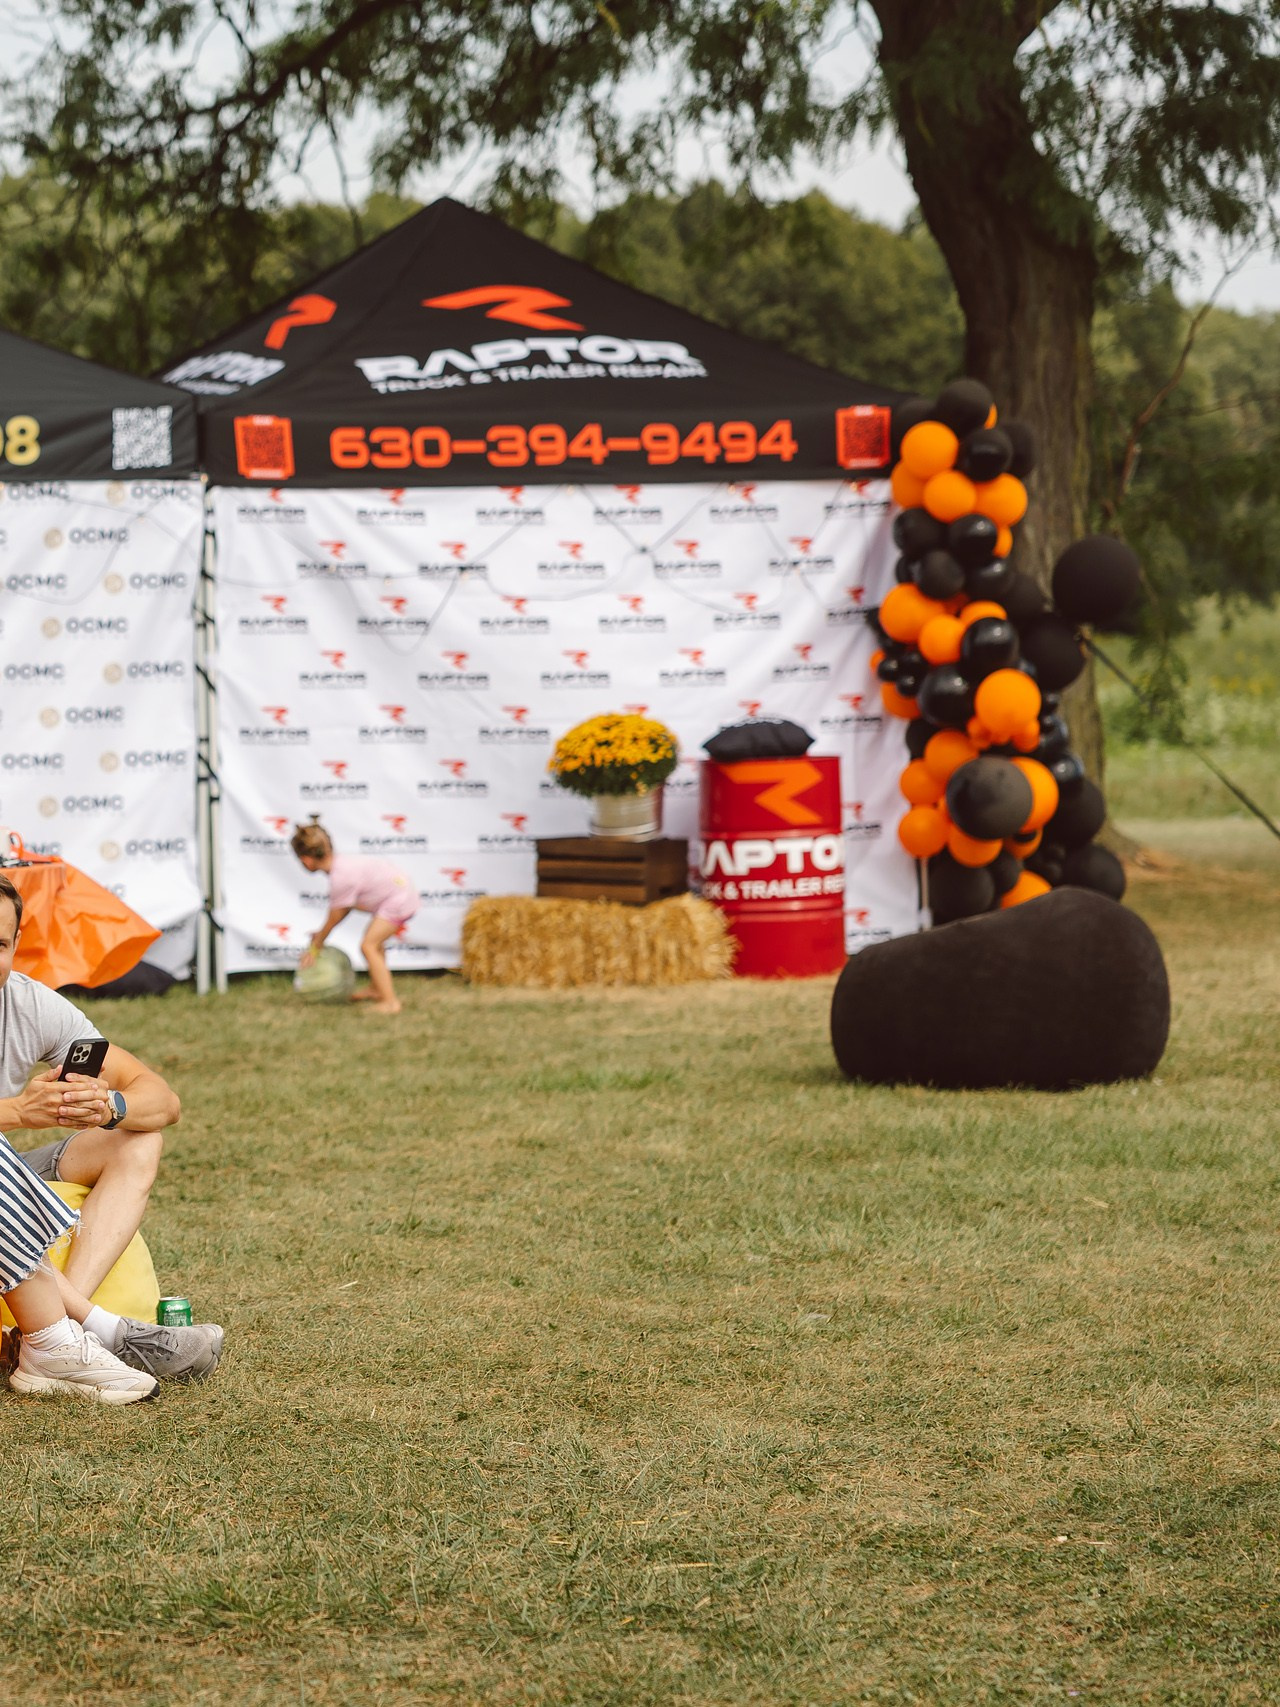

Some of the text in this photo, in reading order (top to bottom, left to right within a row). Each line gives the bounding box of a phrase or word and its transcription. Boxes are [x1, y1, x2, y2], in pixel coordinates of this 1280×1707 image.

[355, 335, 703, 382] RAPTOR
[329, 419, 799, 469] 630-394-9494
[70, 528, 128, 543] OCMC
[7, 574, 68, 589] OCMC
[129, 574, 188, 588] OCMC
[67, 616, 128, 632] OCMC
[4, 664, 65, 678] OCMC
[128, 662, 185, 677] OCMC
[66, 707, 124, 722] OCMC
[1, 753, 64, 768] OCMC
[125, 751, 188, 765] OCMC
[698, 834, 845, 876] APTO
